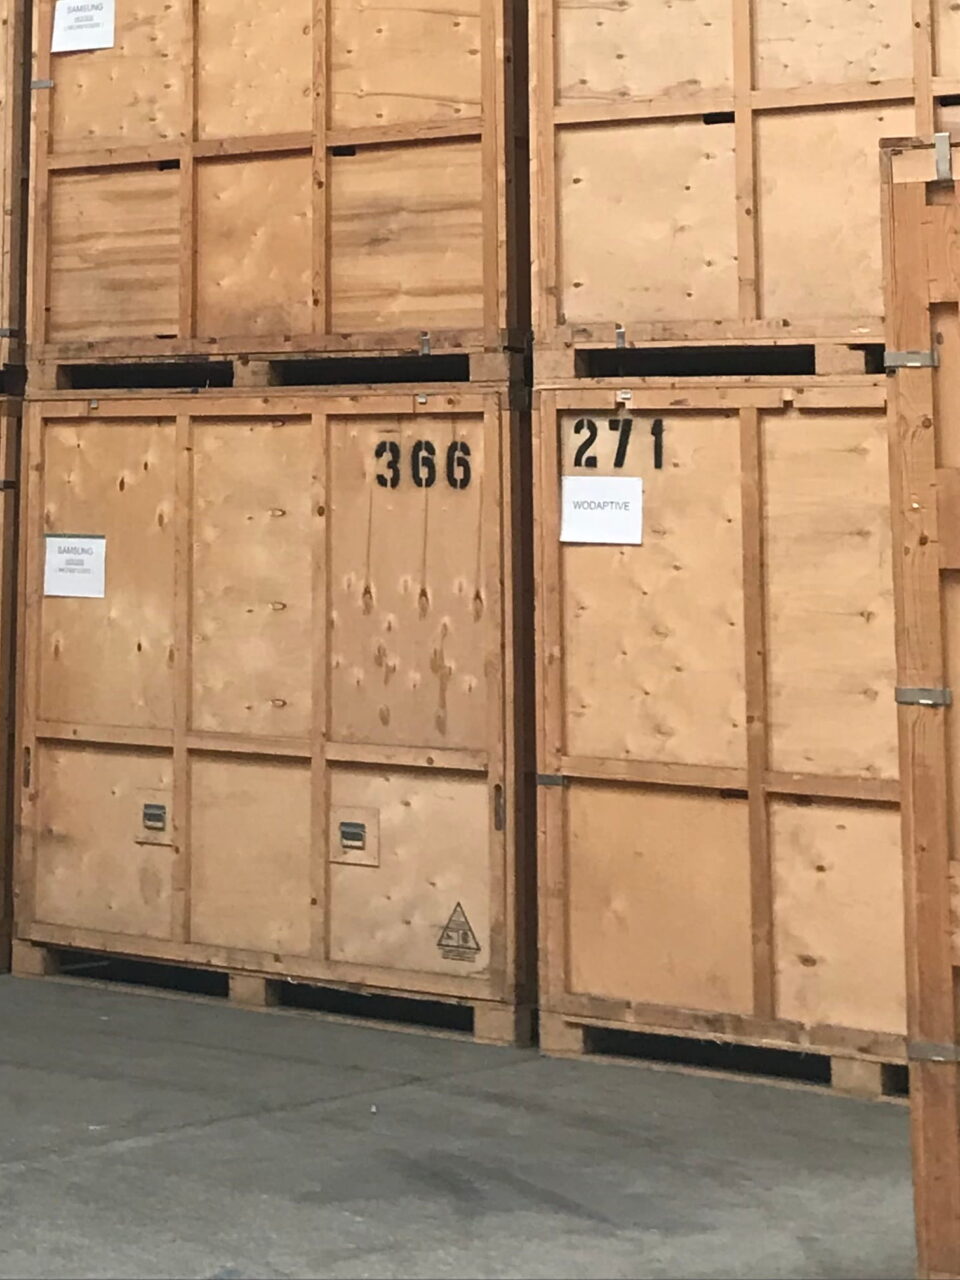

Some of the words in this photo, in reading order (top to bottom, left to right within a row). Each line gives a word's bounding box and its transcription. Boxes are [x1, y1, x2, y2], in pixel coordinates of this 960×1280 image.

[375, 440, 471, 489] 366
[573, 418, 663, 469] 271
[573, 501, 631, 512] WODAPTIVE
